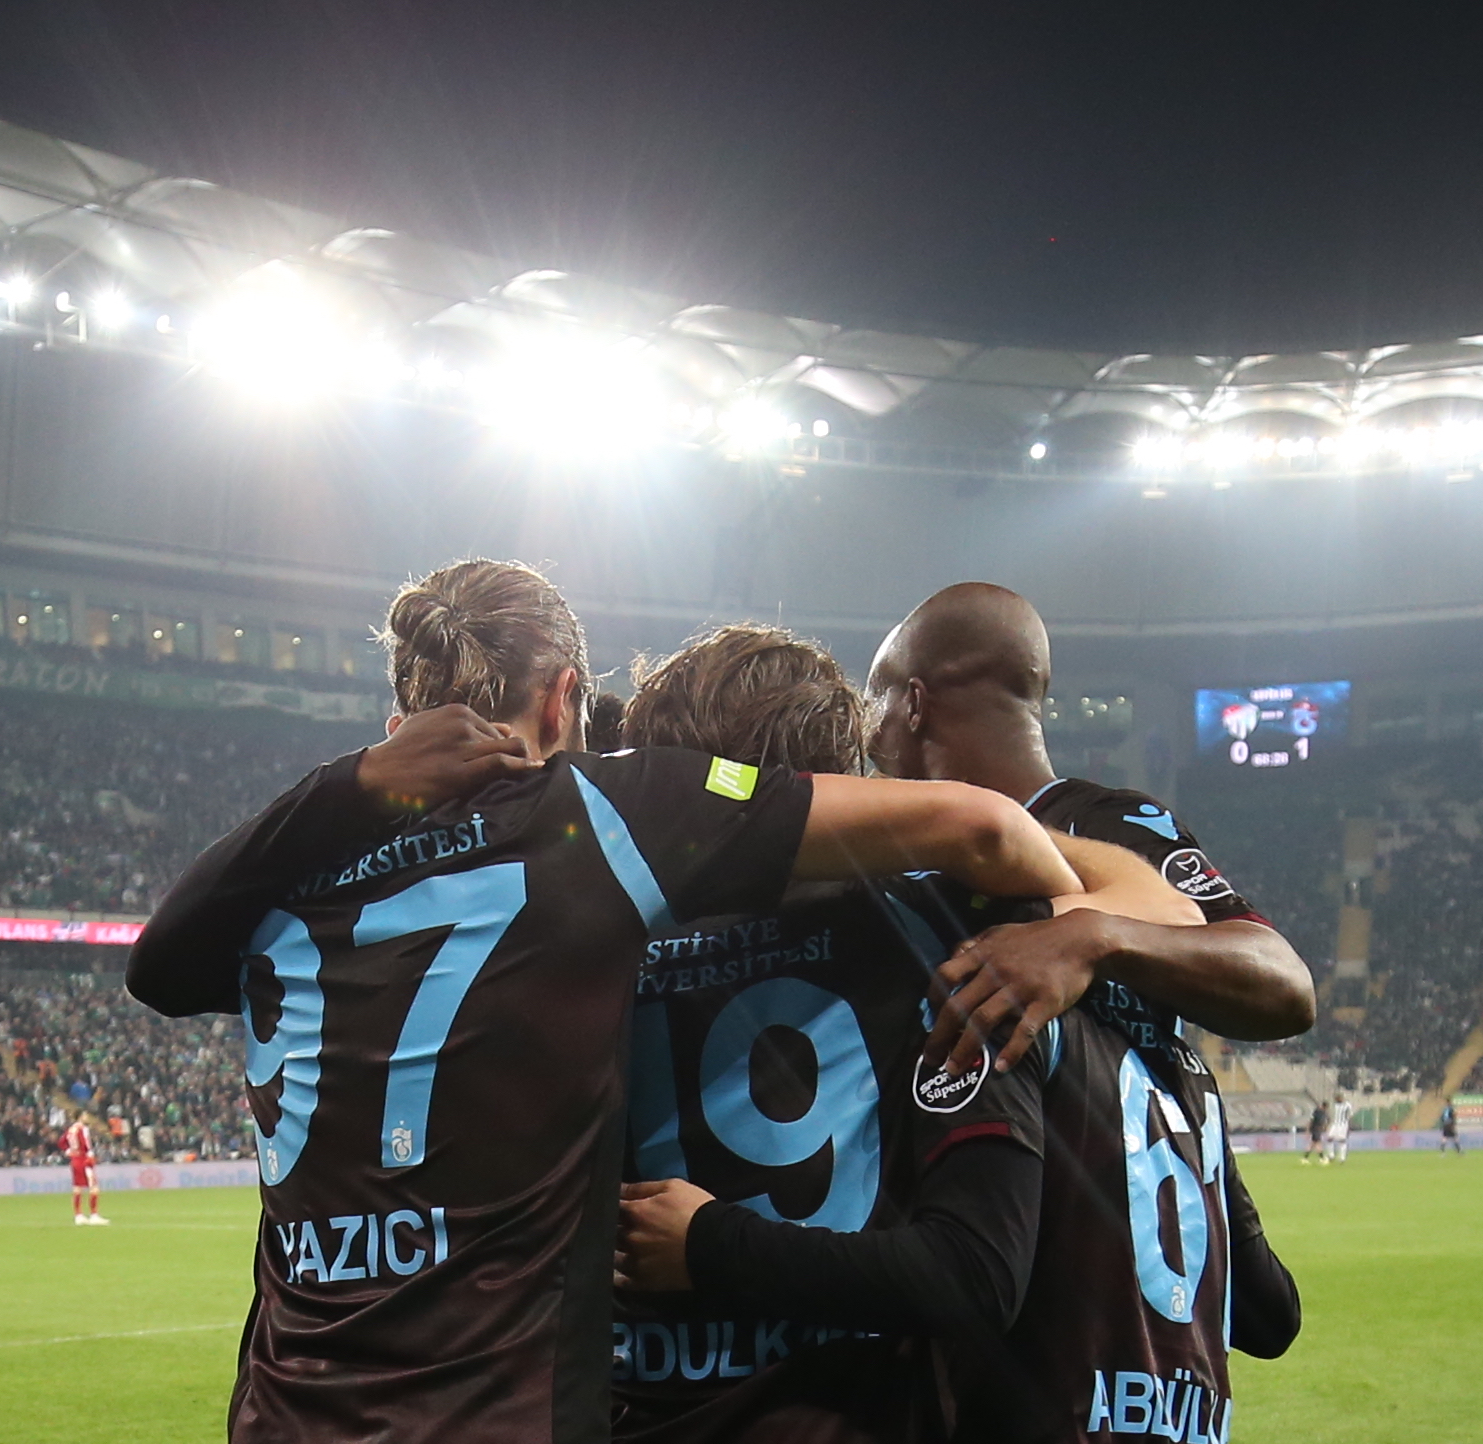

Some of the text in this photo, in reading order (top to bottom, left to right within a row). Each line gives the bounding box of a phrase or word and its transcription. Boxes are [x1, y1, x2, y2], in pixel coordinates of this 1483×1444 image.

[1230, 740, 1249, 764] 0
[1294, 736, 1310, 760] 1
[275, 1206, 450, 1284] YAZICI
